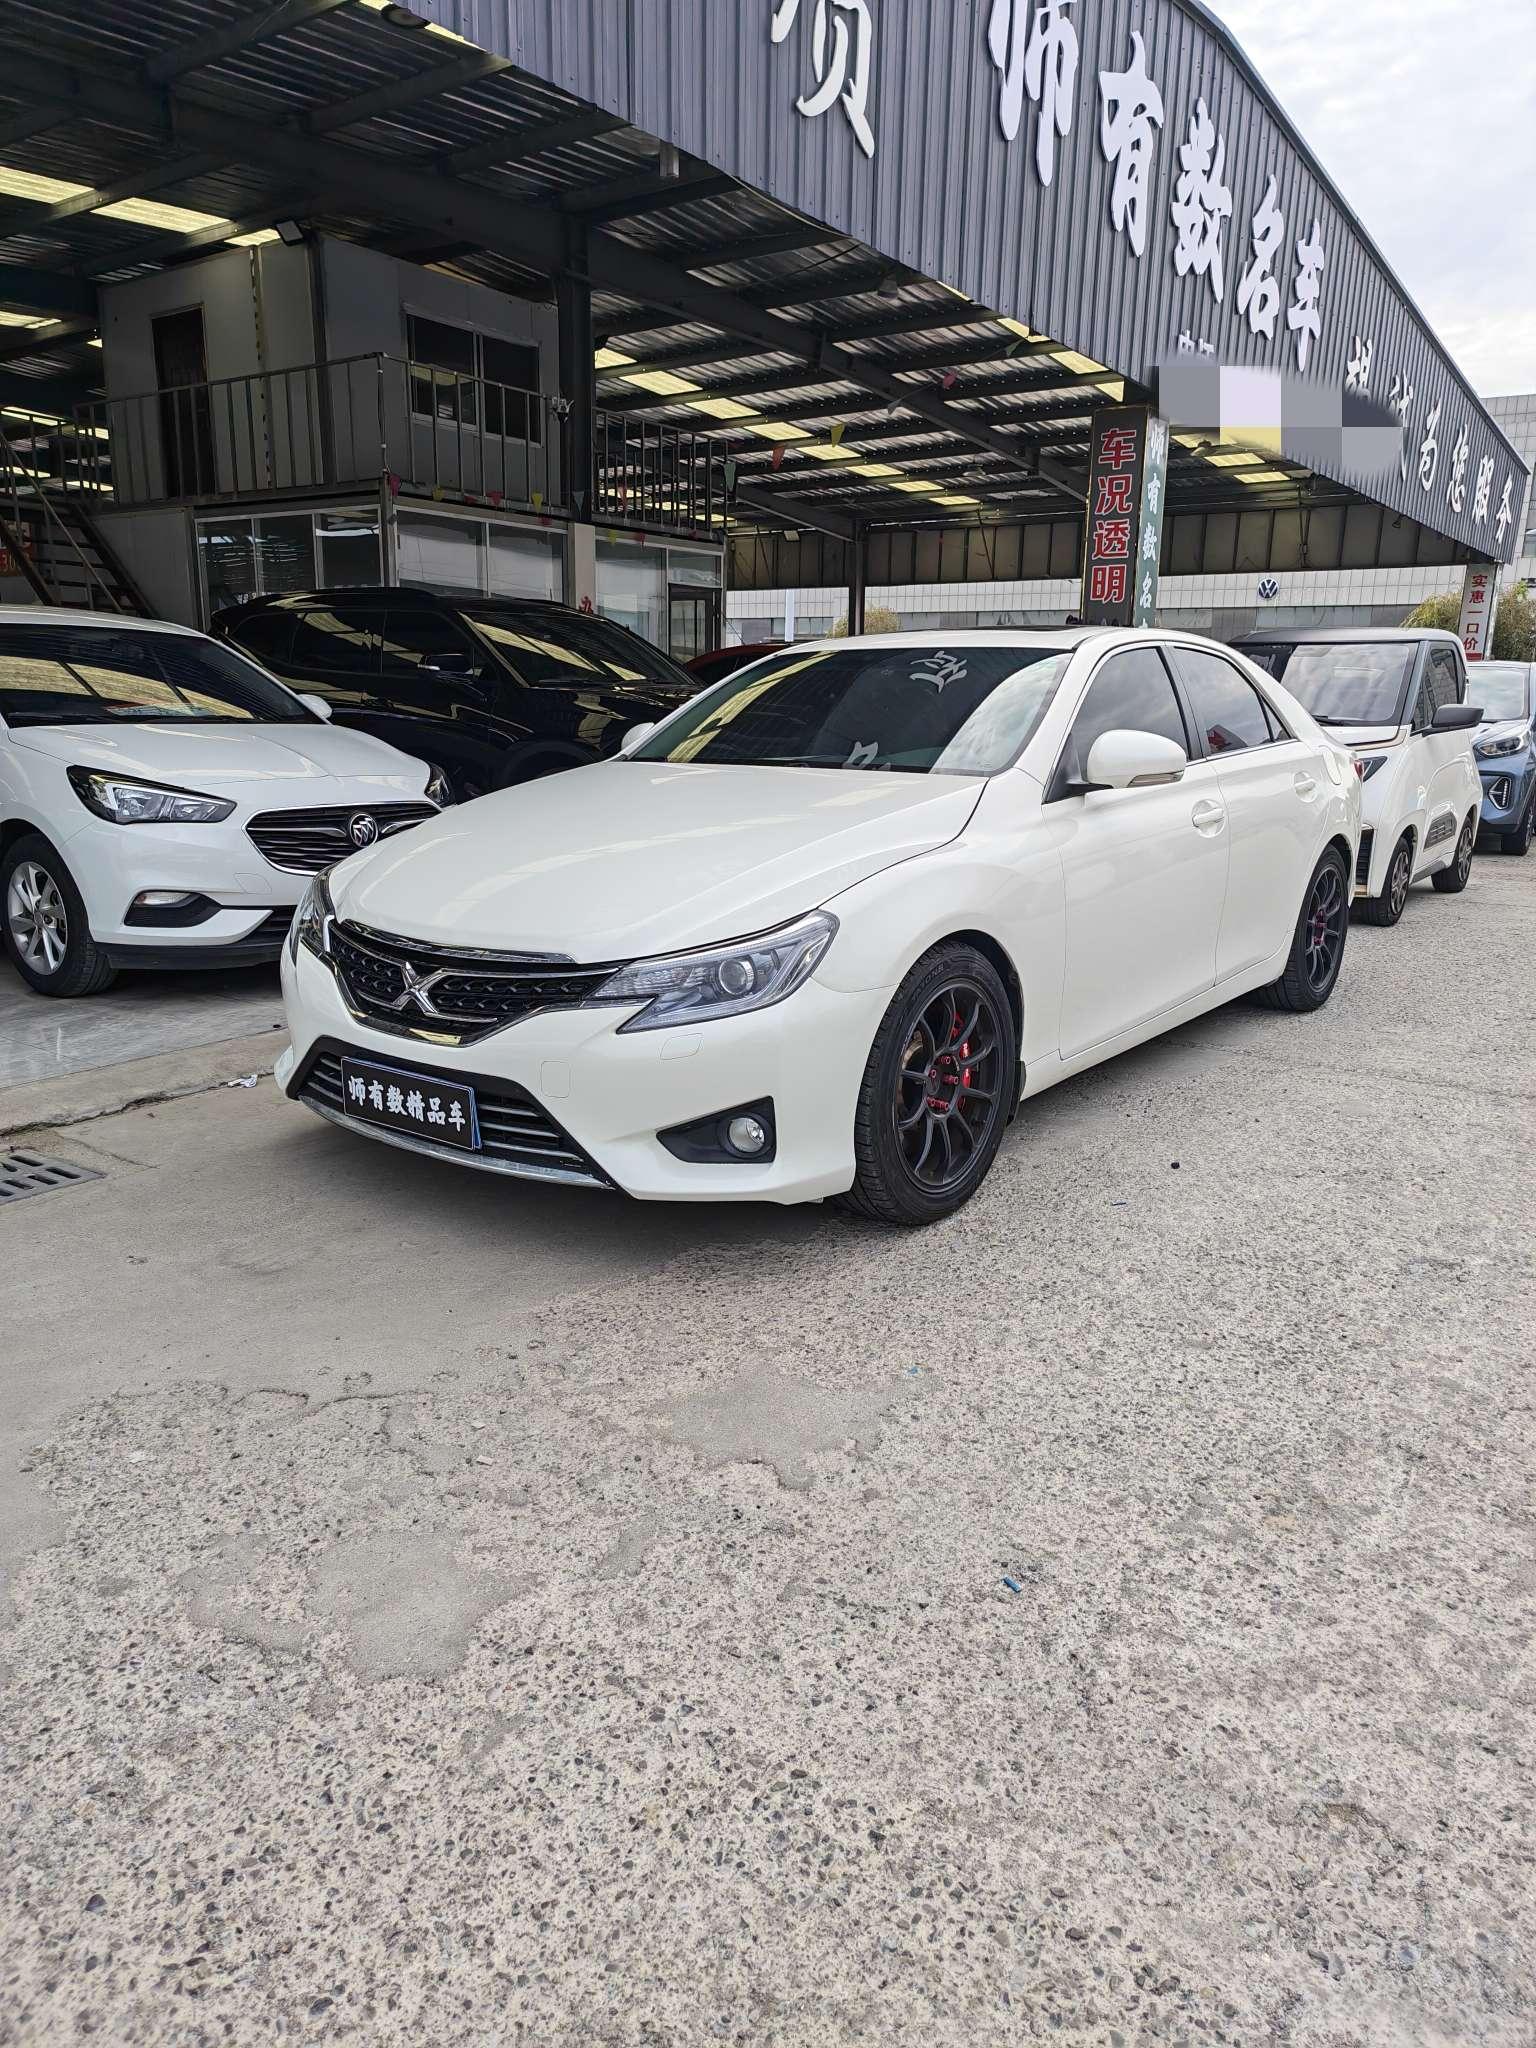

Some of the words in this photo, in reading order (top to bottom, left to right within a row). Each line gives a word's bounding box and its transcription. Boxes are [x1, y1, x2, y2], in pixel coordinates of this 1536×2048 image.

[1090, 428, 1136, 604] 车况透明
[1139, 424, 1164, 629] 师有数名
[1463, 574, 1488, 650] 实惠一口价
[348, 1075, 466, 1132] 师有数精品车
